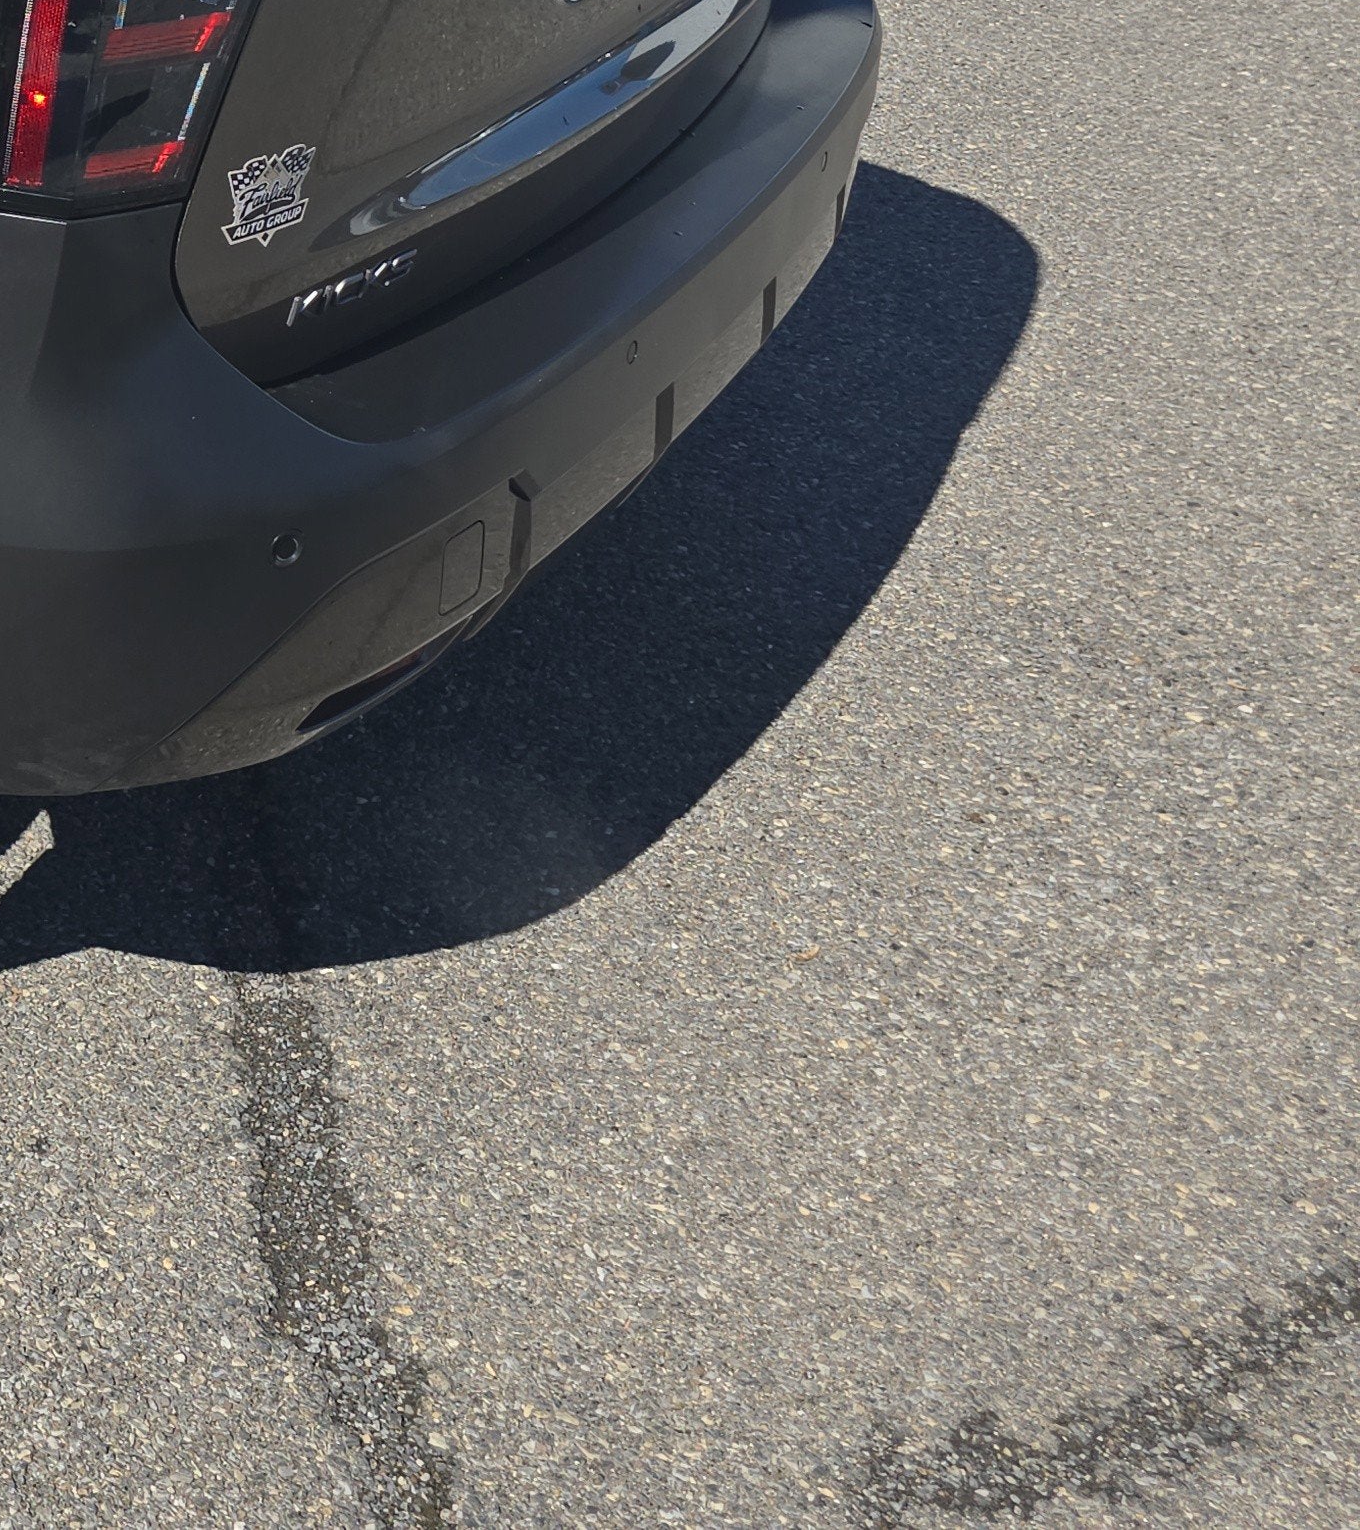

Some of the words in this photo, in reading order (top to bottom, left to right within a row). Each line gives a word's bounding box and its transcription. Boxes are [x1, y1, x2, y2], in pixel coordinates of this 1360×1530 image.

[232, 219, 265, 240] AUTO
[265, 205, 302, 229] GROUP
[286, 248, 418, 328] KICKS
